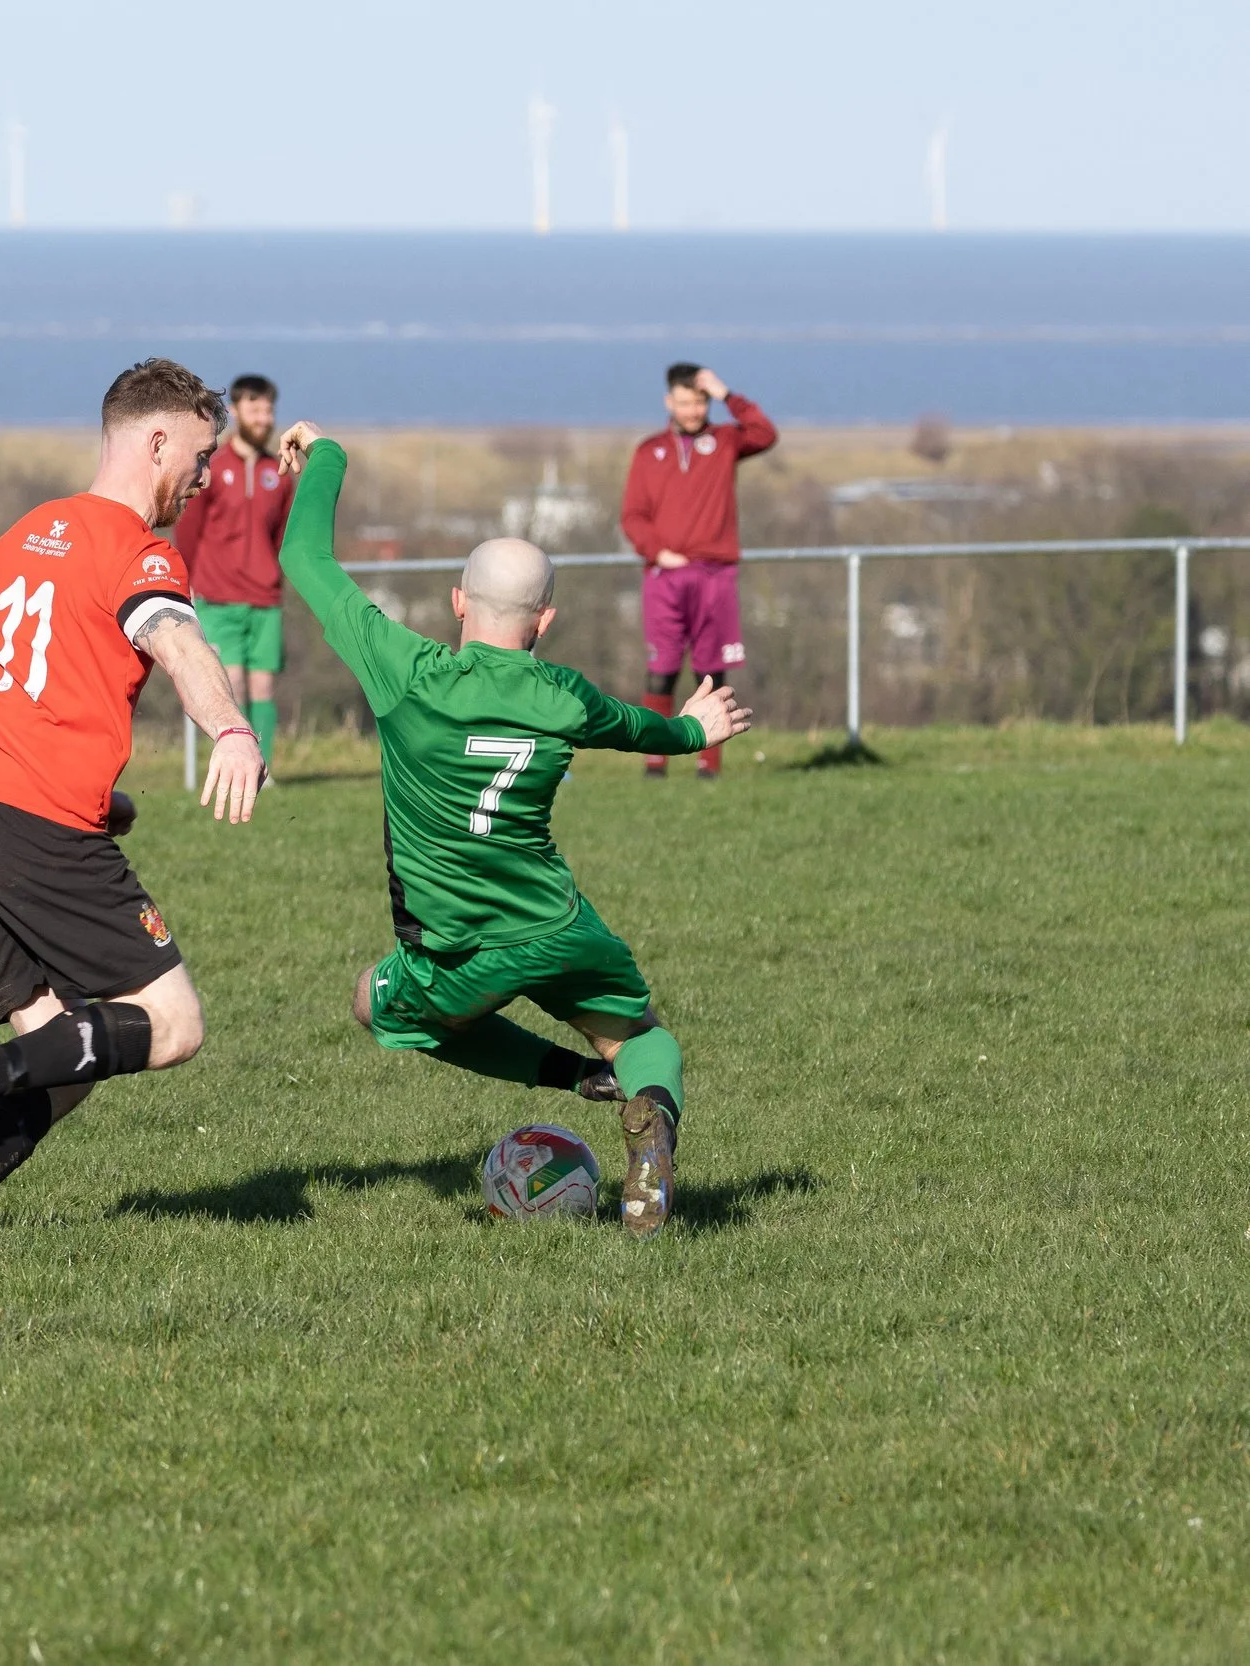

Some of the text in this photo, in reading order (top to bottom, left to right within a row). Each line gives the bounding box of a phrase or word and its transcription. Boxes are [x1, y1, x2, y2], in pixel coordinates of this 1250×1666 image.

[21, 542, 66, 557] cleaning services
[26, 533, 72, 551] RG HOWELLS
[132, 578, 146, 586] THE
[464, 735, 536, 837] 7
